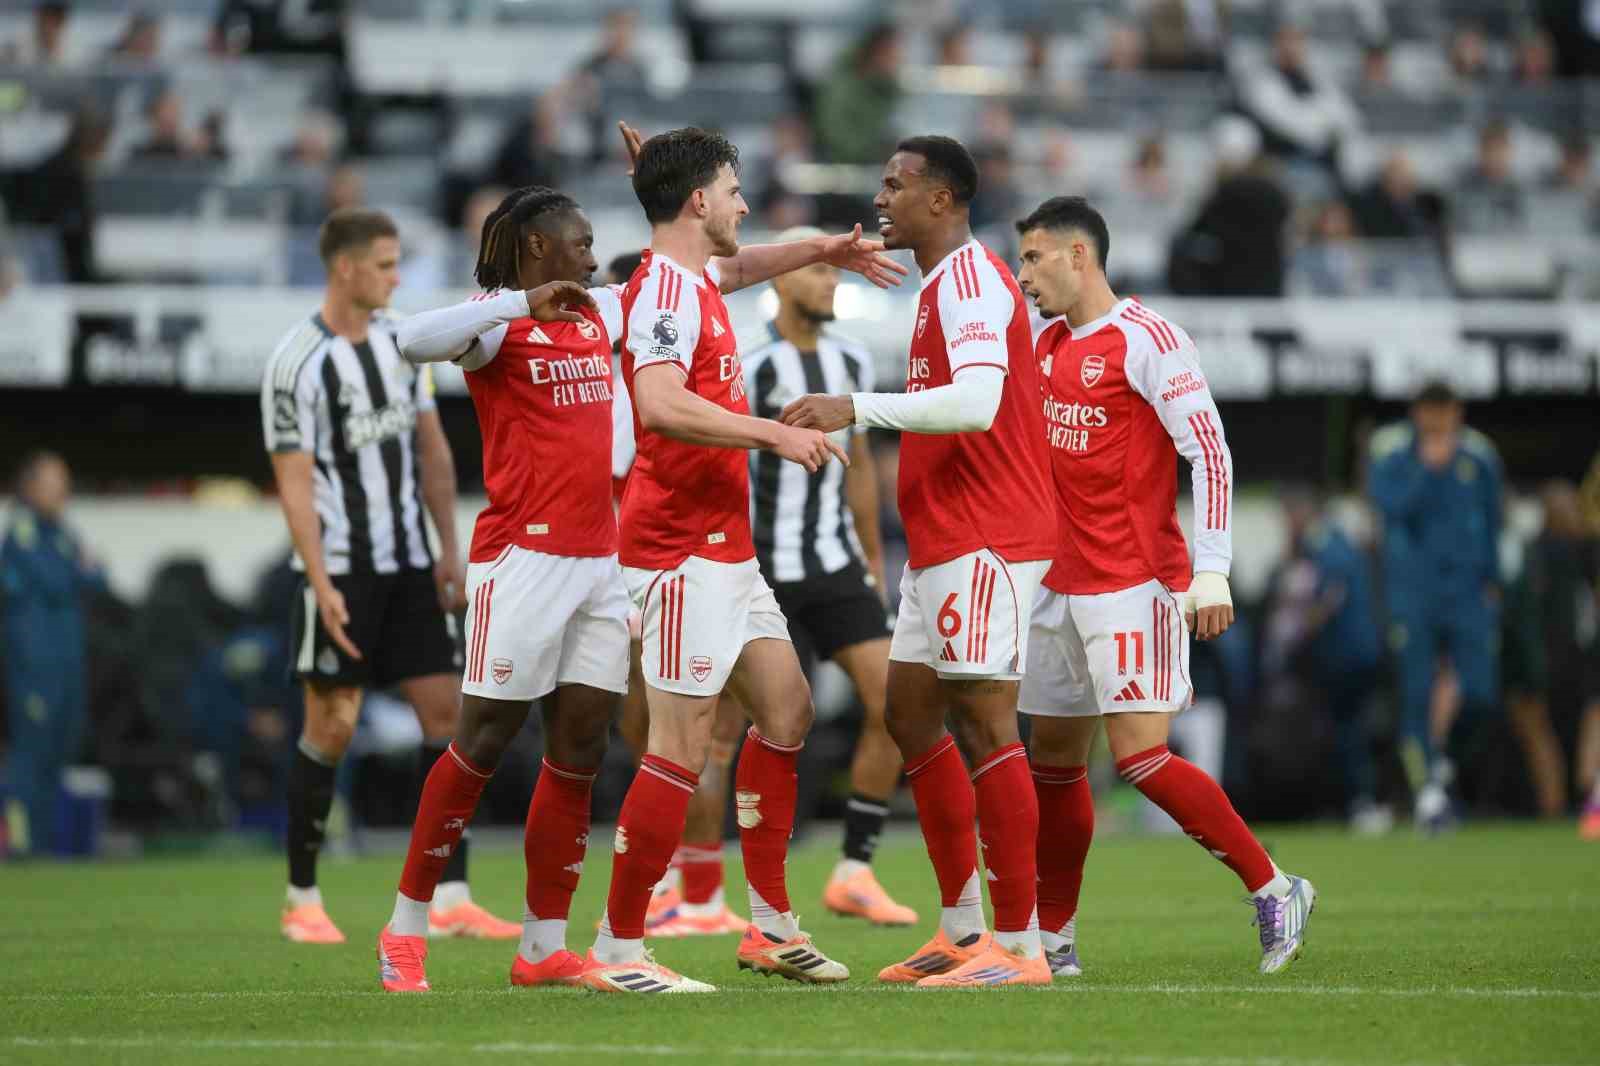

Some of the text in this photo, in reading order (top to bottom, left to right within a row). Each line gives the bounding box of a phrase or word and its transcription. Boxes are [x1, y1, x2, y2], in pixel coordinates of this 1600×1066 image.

[959, 322, 984, 334] VISIT
[951, 333, 998, 349] RWANDA
[1168, 371, 1192, 386] VISIT
[553, 384, 575, 407] FLY
[1161, 380, 1206, 402] RWANDA
[937, 592, 962, 638] 6
[1114, 632, 1144, 675] 11
